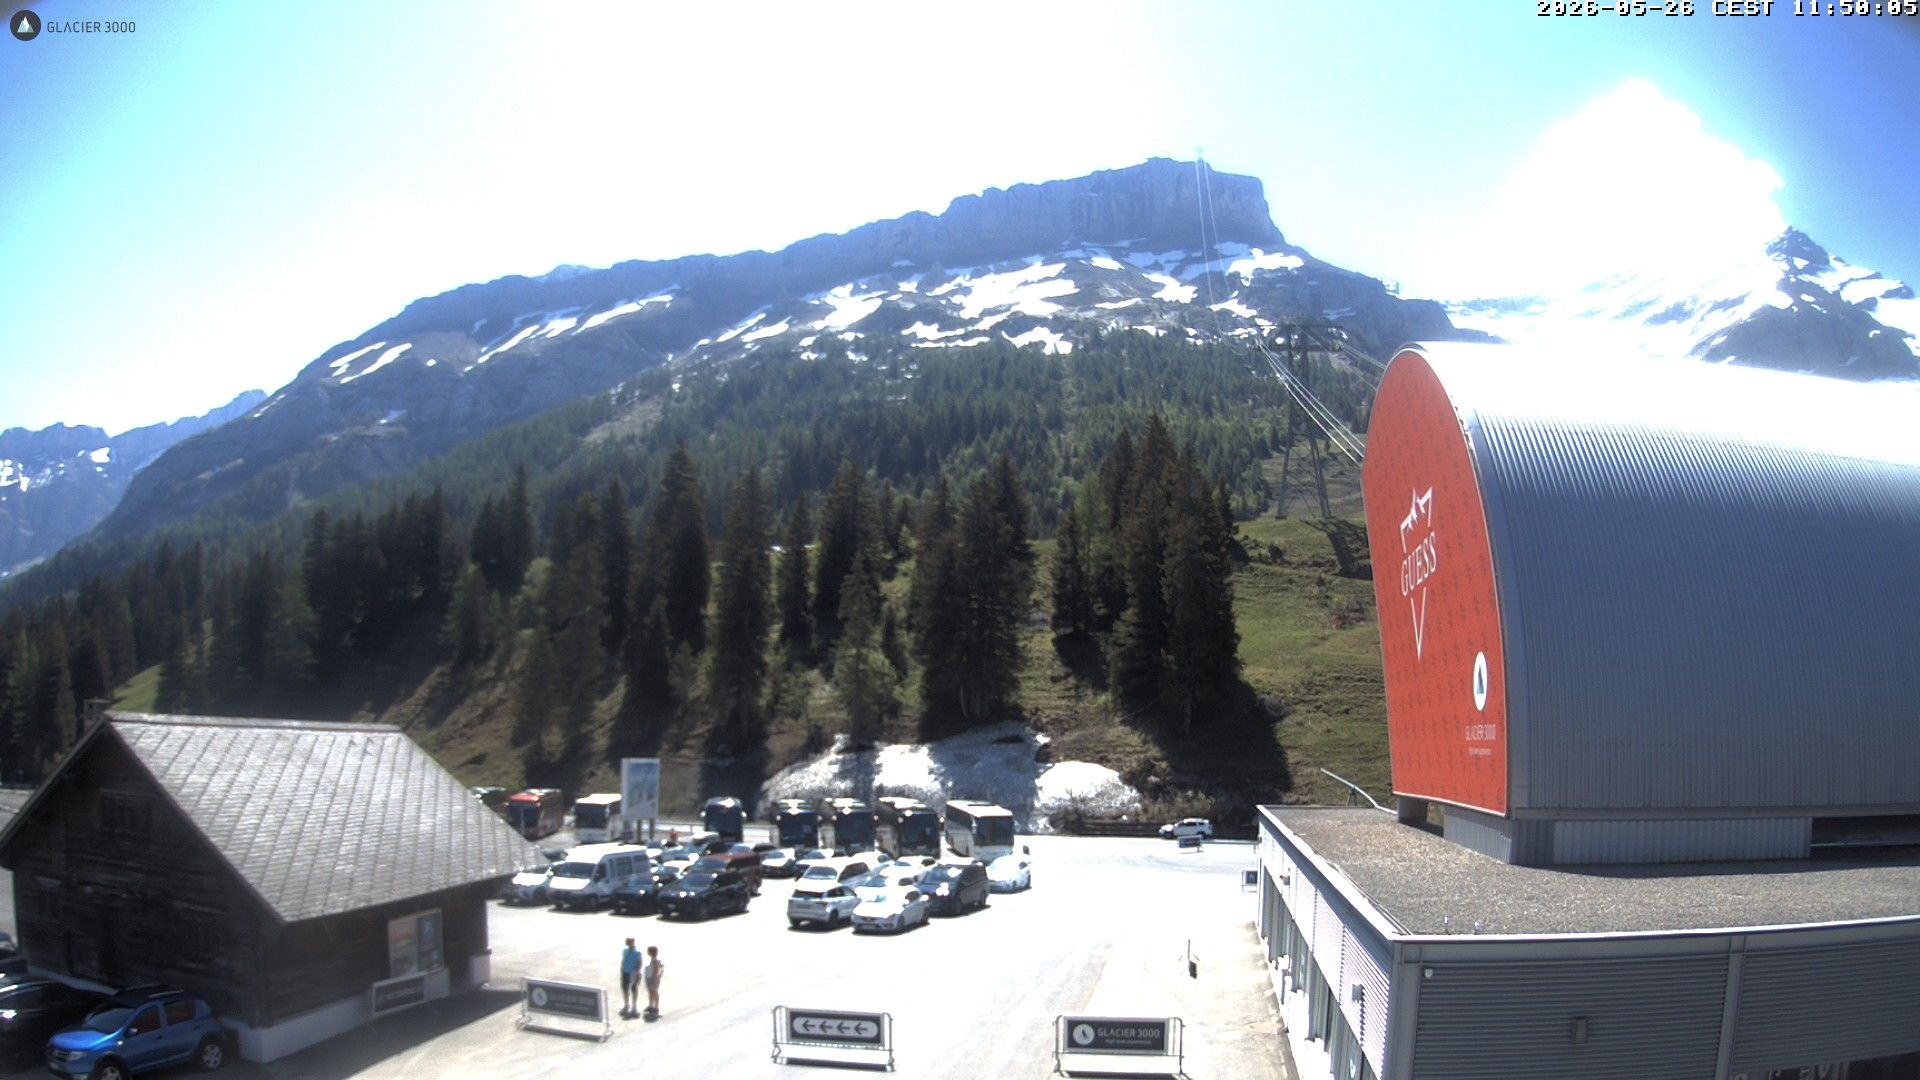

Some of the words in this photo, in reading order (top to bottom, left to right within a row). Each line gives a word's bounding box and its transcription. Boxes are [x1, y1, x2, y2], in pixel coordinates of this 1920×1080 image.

[1400, 532, 1438, 597] GUESS
[1097, 1027, 1135, 1038] GLACIER
[1137, 1028, 1161, 1039] 3000
